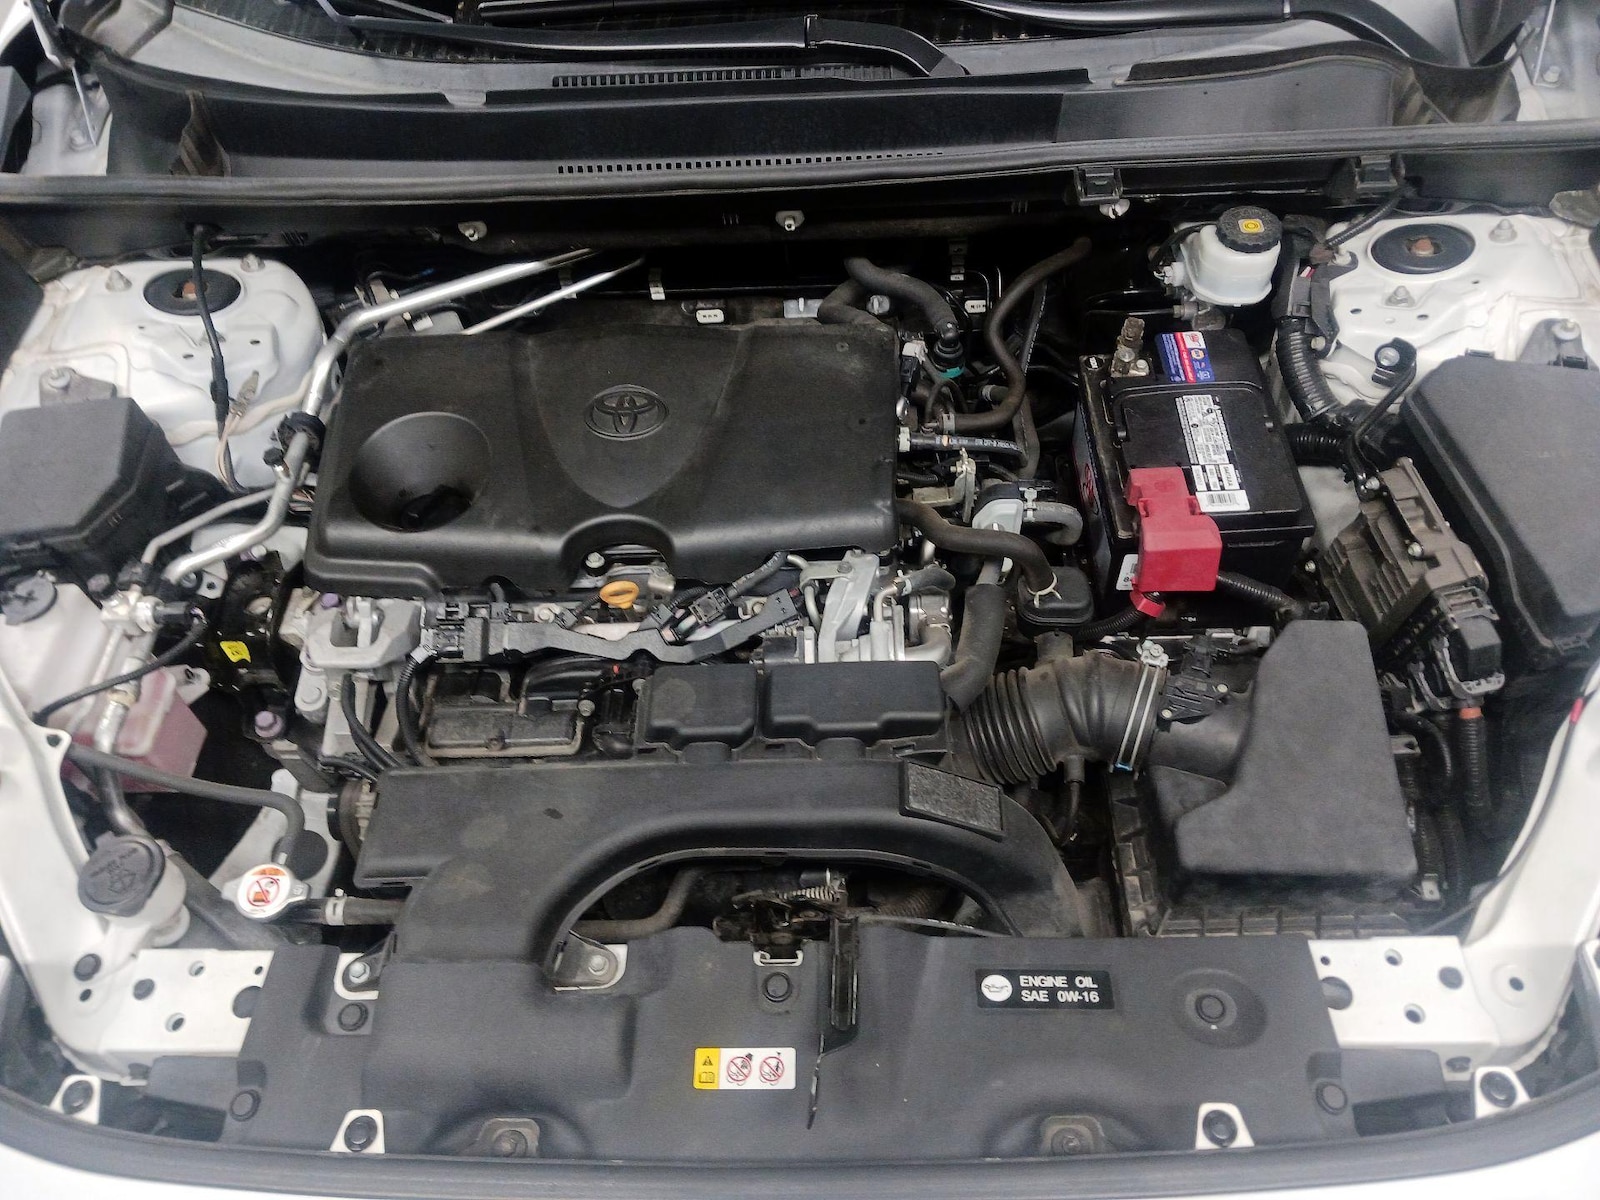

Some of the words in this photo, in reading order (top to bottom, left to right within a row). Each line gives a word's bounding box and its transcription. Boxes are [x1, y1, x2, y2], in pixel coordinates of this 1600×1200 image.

[1019, 975, 1068, 988] ENGINE
[1074, 976, 1098, 988] OIL
[1021, 990, 1049, 1002] SAE
[1057, 990, 1100, 1003] 0W-16
